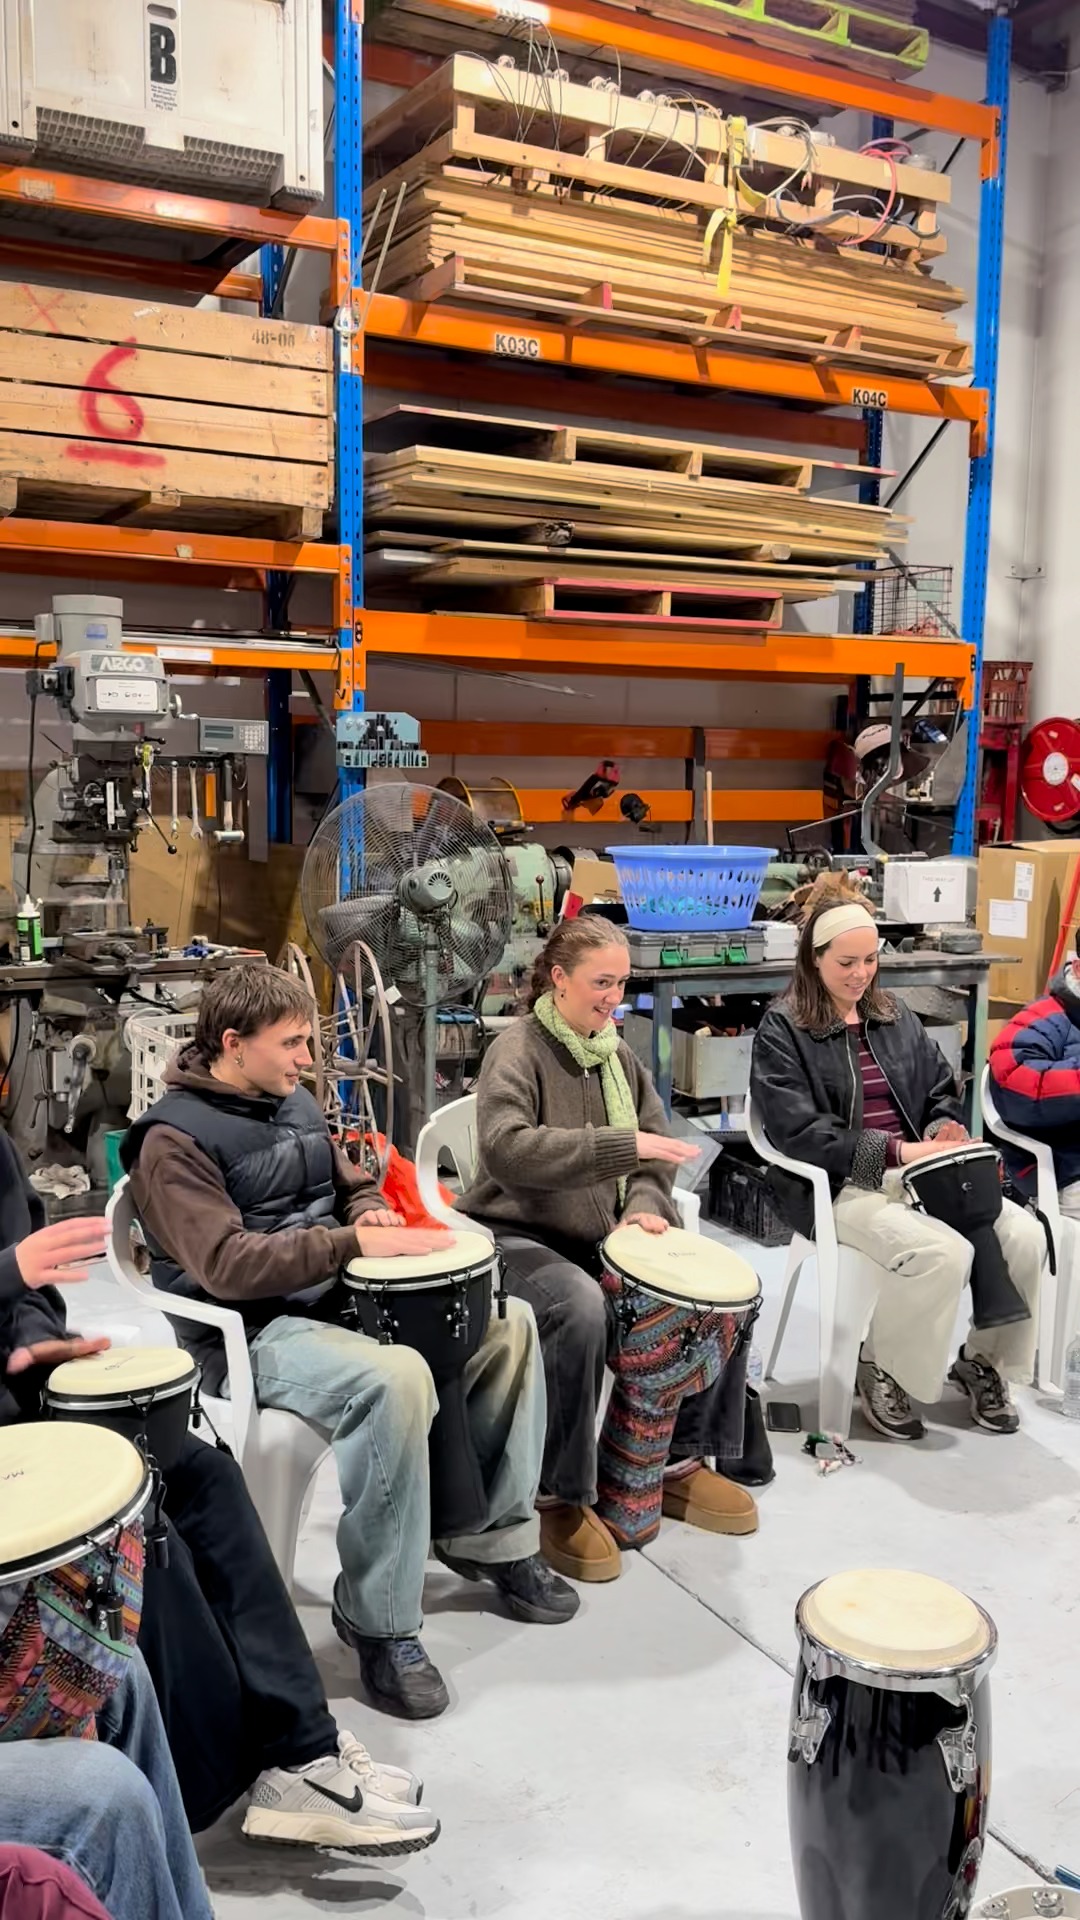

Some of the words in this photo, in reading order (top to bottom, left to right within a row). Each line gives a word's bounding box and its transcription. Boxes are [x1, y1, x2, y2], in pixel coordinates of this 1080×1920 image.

[150, 22, 176, 84] B
[495, 333, 538, 357] K03C
[80, 335, 145, 440] 6
[853, 388, 887, 407] K04C
[99, 656, 146, 672] ARGO
